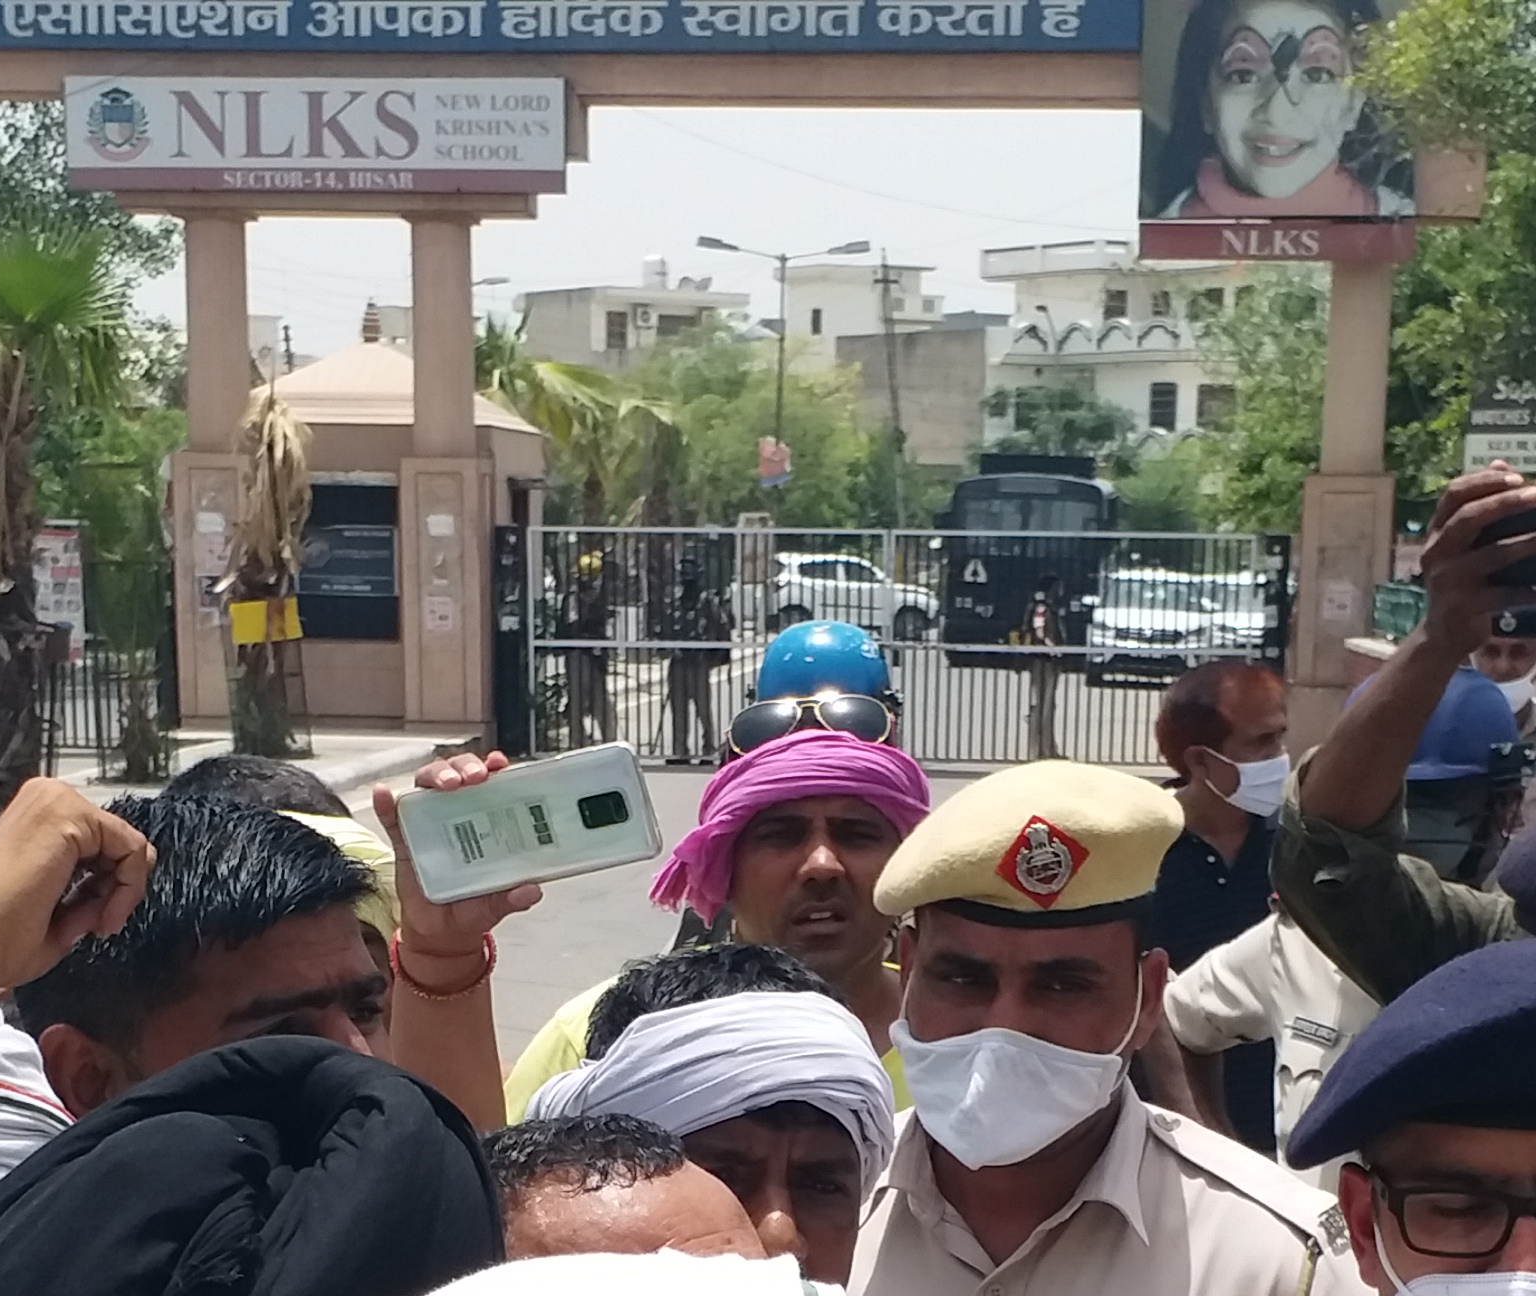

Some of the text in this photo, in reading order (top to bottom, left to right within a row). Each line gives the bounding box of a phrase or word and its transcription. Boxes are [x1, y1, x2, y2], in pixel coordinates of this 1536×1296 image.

[306, 0, 488, 38] आपका
[682, 0, 865, 38] स्वागत
[435, 94, 552, 112] NEW LORD
[168, 89, 420, 161] NLKS
[434, 119, 551, 137] KRISHNA'S
[434, 144, 525, 162] SCHOOL
[349, 170, 415, 189] HISAR
[1221, 228, 1321, 256] NLKS
